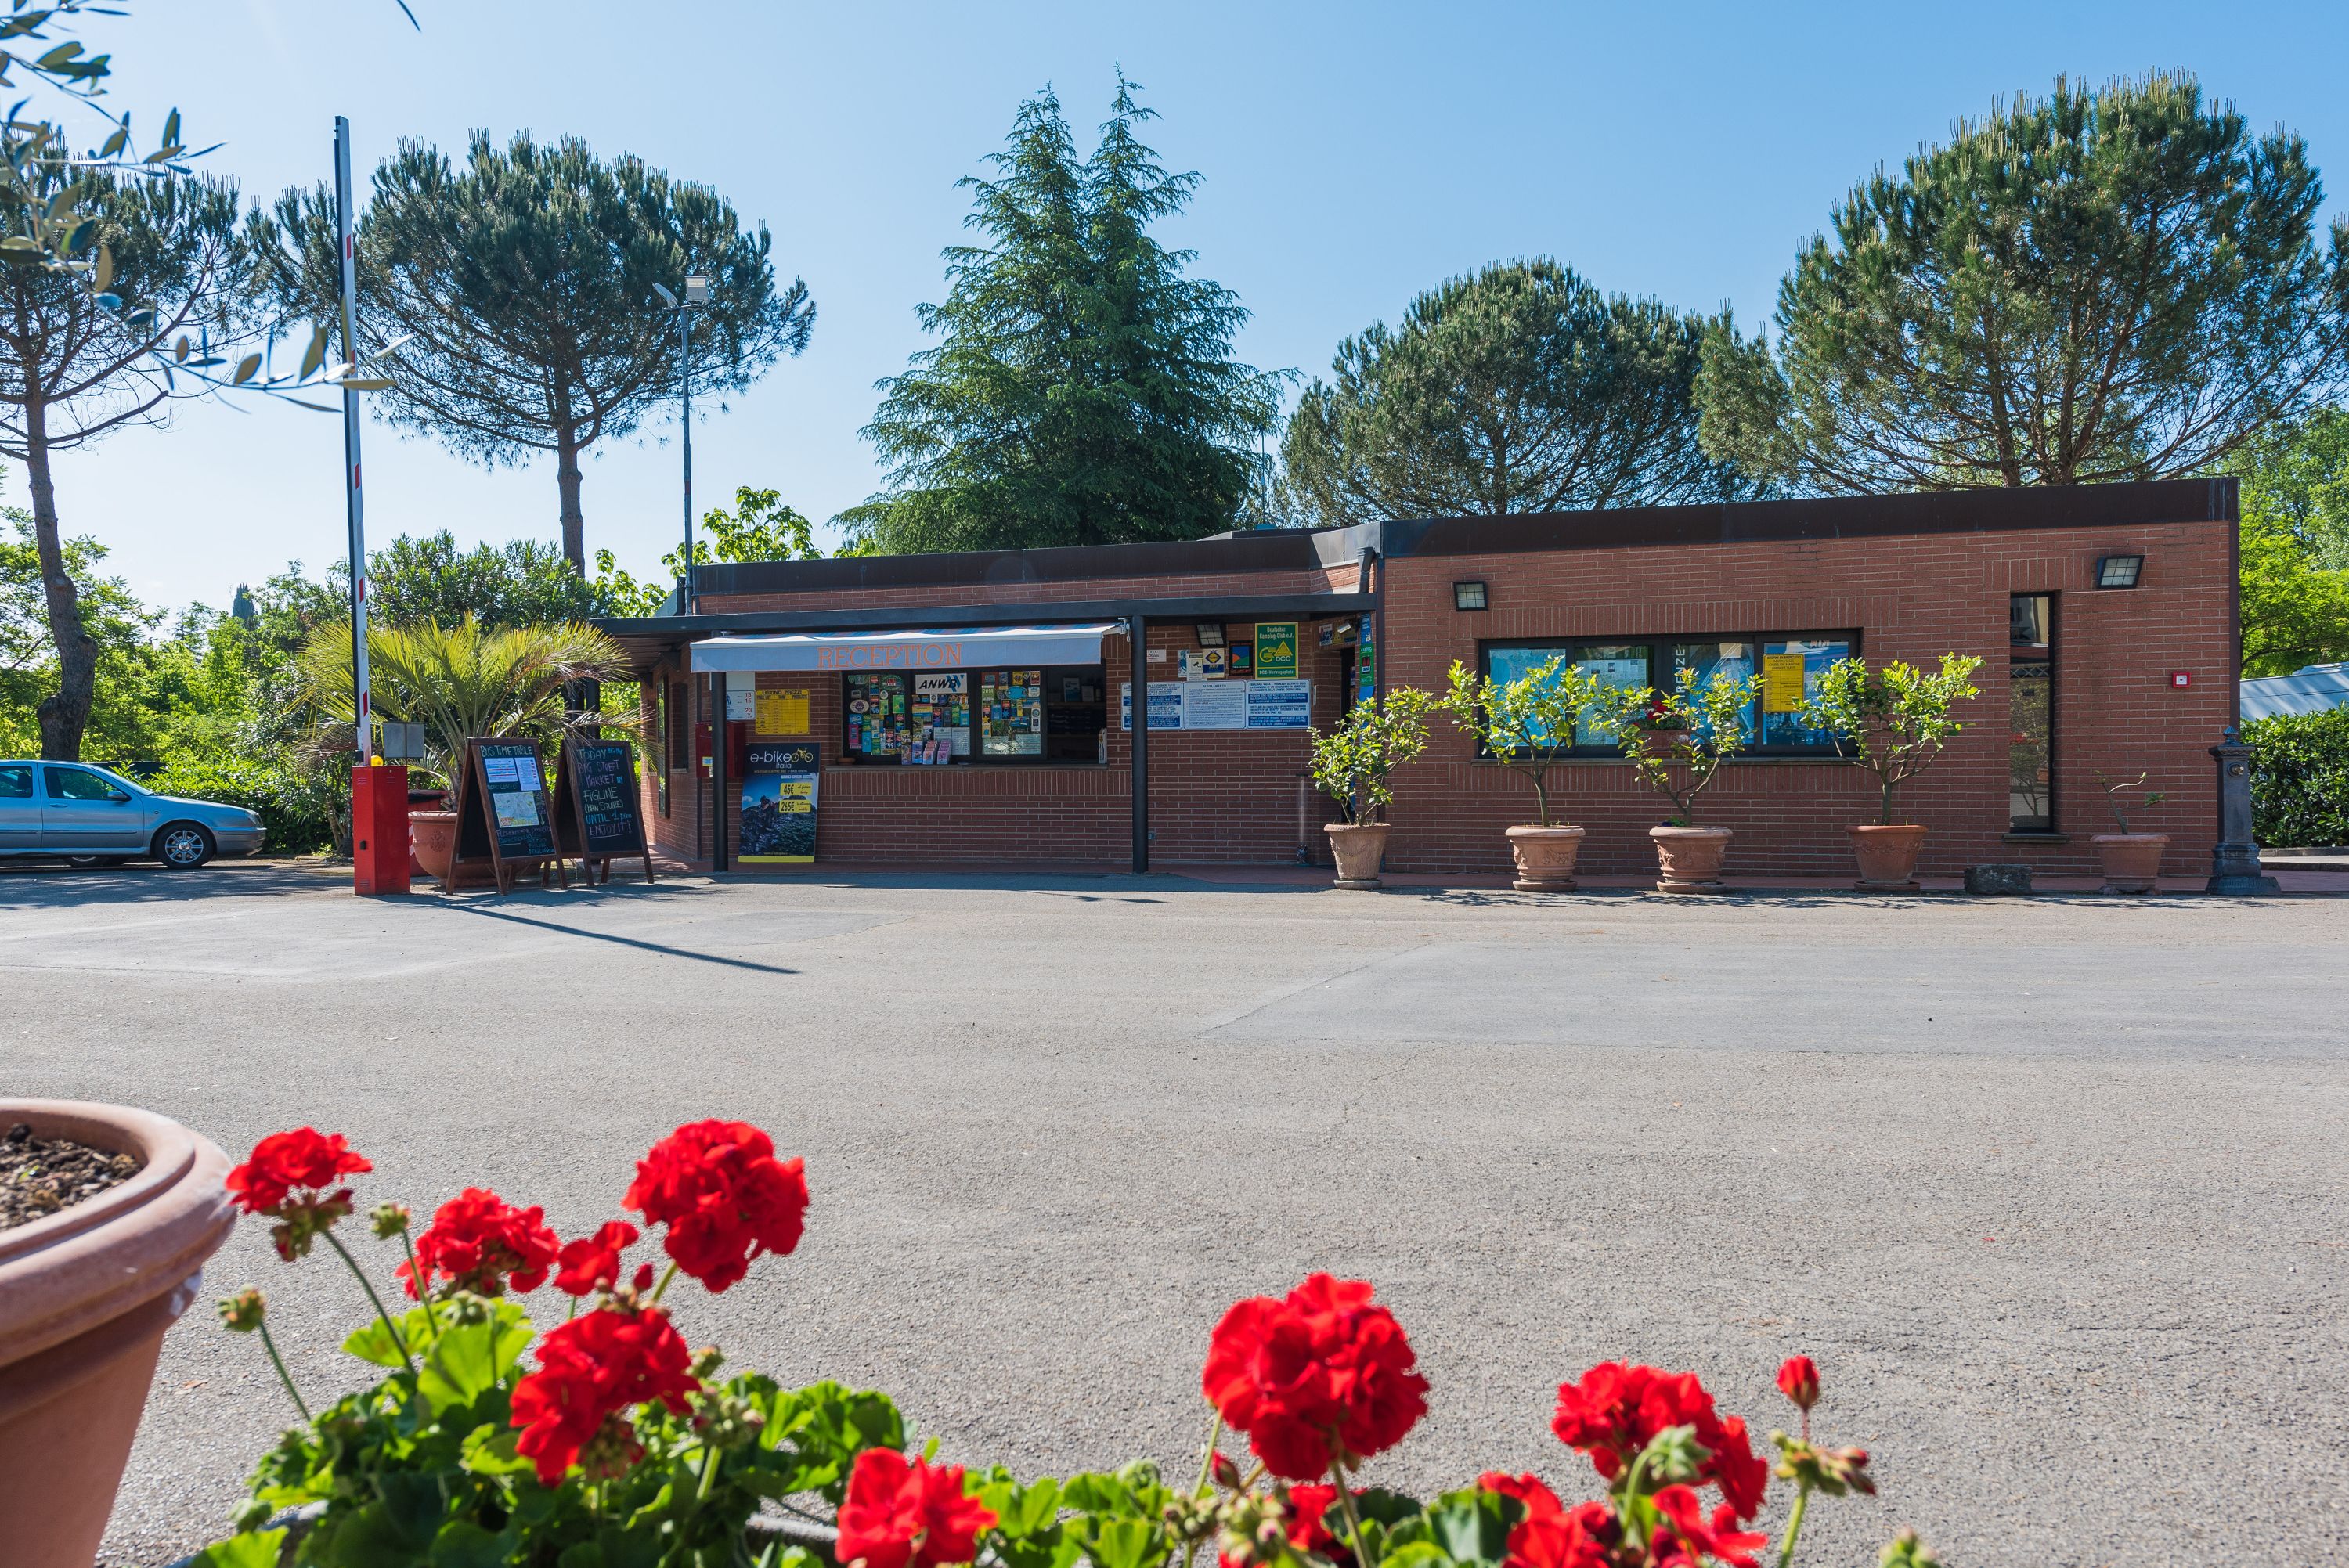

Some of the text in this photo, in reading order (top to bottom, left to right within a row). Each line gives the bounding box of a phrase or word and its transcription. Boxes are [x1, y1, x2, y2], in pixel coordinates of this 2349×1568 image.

[817, 643, 962, 669] RECEPTION
[919, 679, 957, 690] ANWB
[480, 744, 495, 757] BUS
[577, 748, 607, 760] TODAY
[750, 751, 792, 763] e-bike
[577, 759, 619, 774] BIG STREET
[585, 773, 615, 788] MARKET
[583, 786, 619, 802] FIGLINE
[783, 784, 794, 795] 45€
[781, 802, 795, 812] 265€
[586, 813, 610, 824] UNTIL
[590, 821, 615, 836] ENJOY
